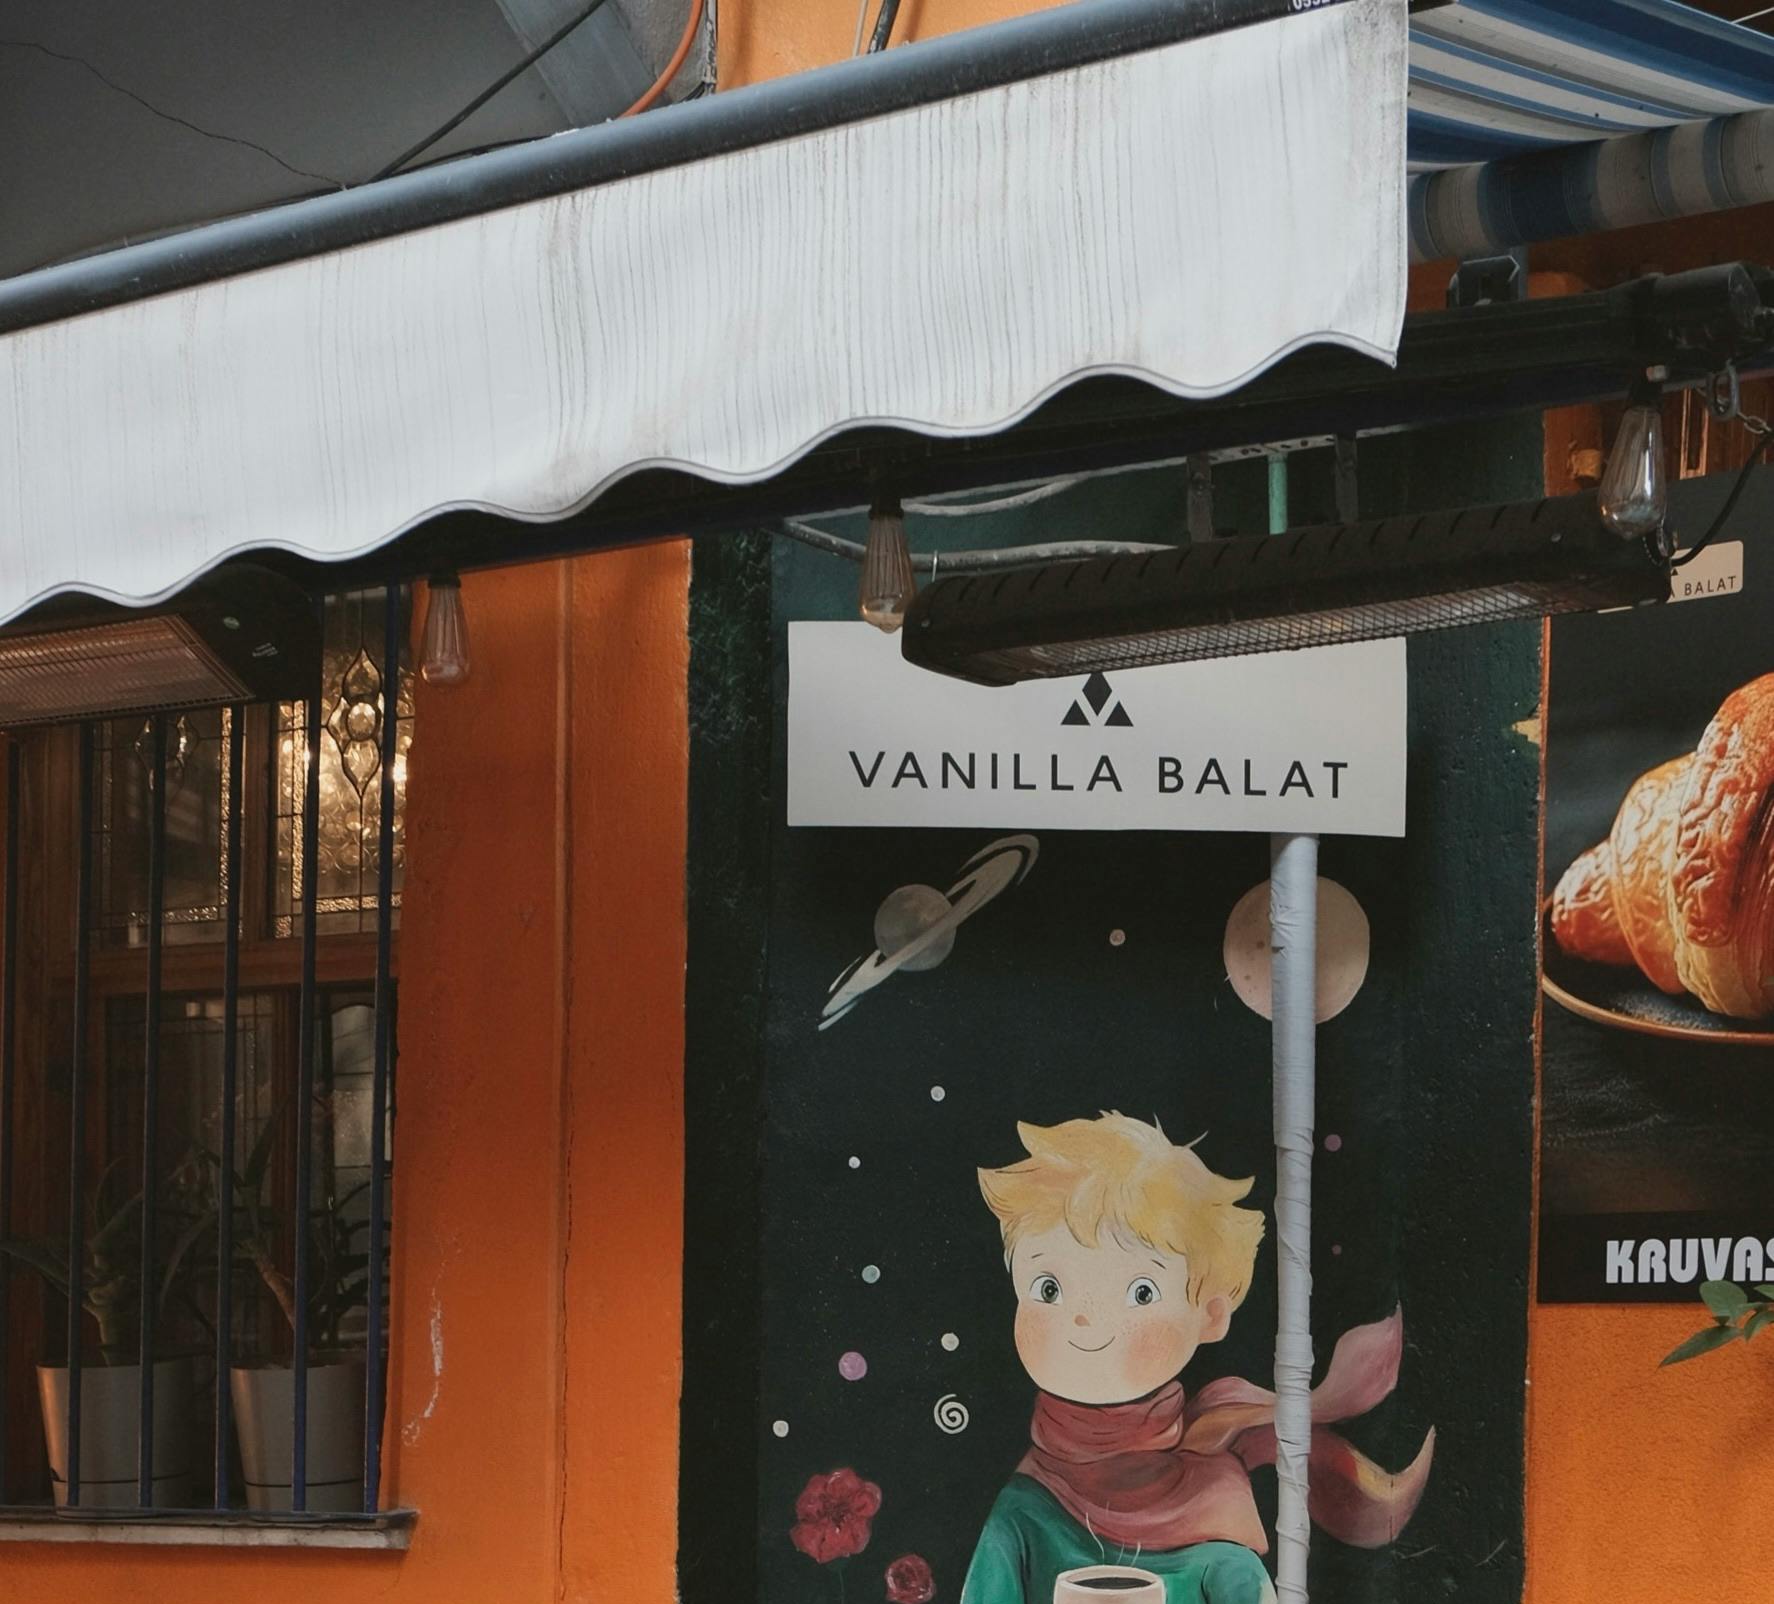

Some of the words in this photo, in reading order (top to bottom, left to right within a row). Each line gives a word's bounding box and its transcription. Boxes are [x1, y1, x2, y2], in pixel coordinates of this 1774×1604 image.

[1684, 576, 1737, 596] BALAT
[849, 750, 1123, 792] VANILLA
[1158, 756, 1349, 799] BALAT
[1606, 1236, 1774, 1284] KRUVA
